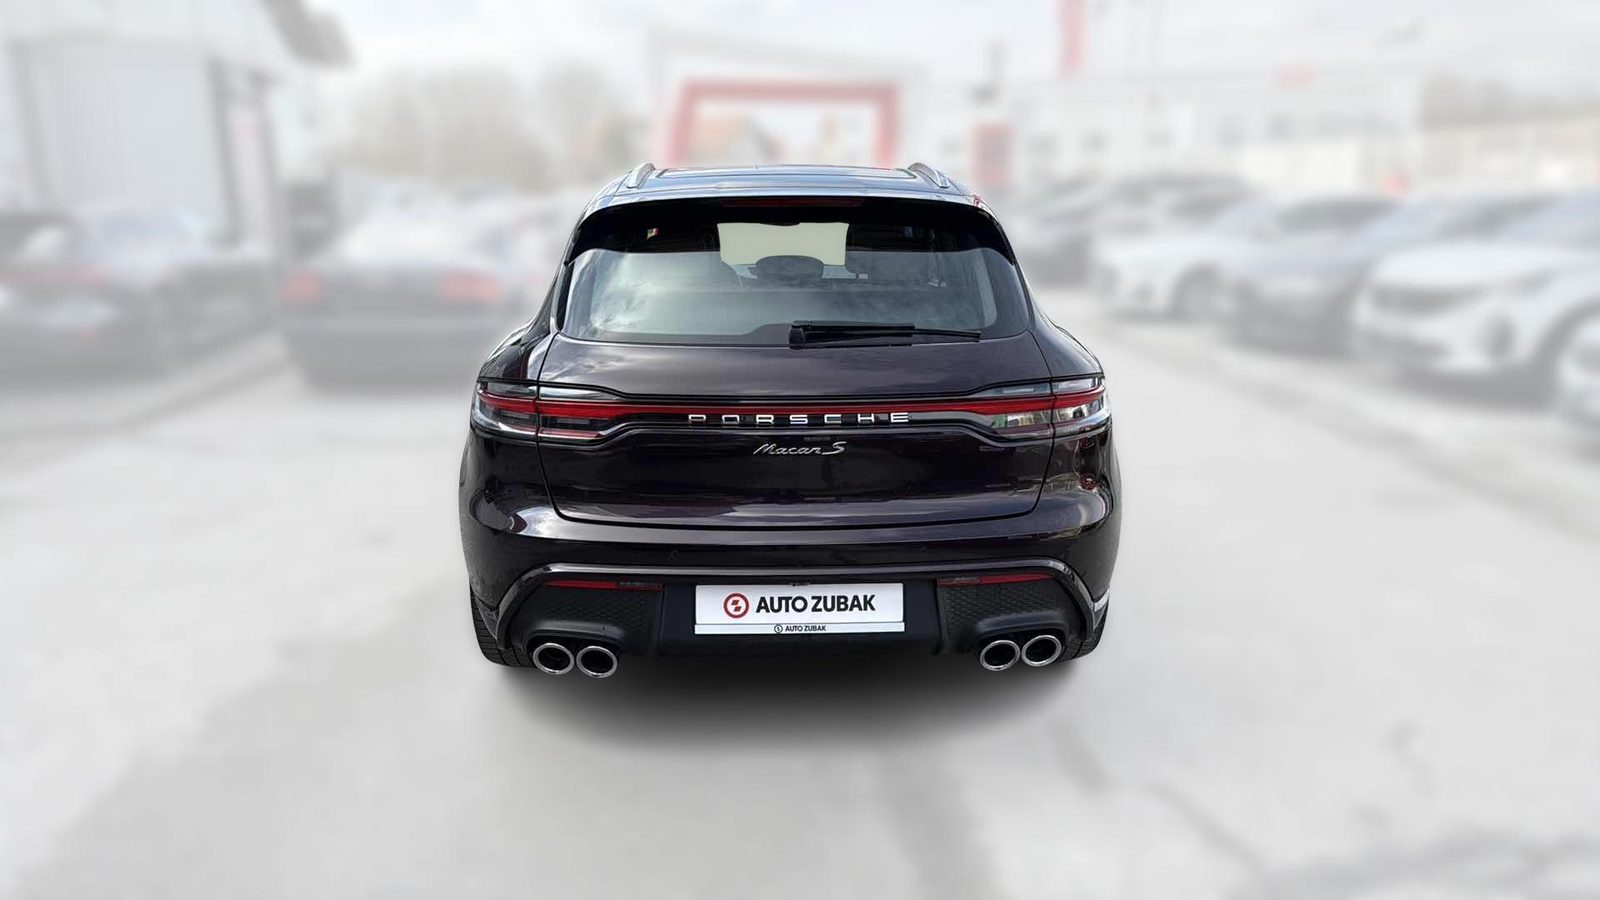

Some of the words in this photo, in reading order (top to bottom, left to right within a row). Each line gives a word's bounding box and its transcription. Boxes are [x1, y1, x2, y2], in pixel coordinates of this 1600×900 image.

[688, 412, 909, 425] PORSCHE
[753, 443, 822, 455] Macan
[822, 441, 847, 455] S
[756, 596, 808, 613] AUTO
[811, 594, 876, 612] ZUBAK
